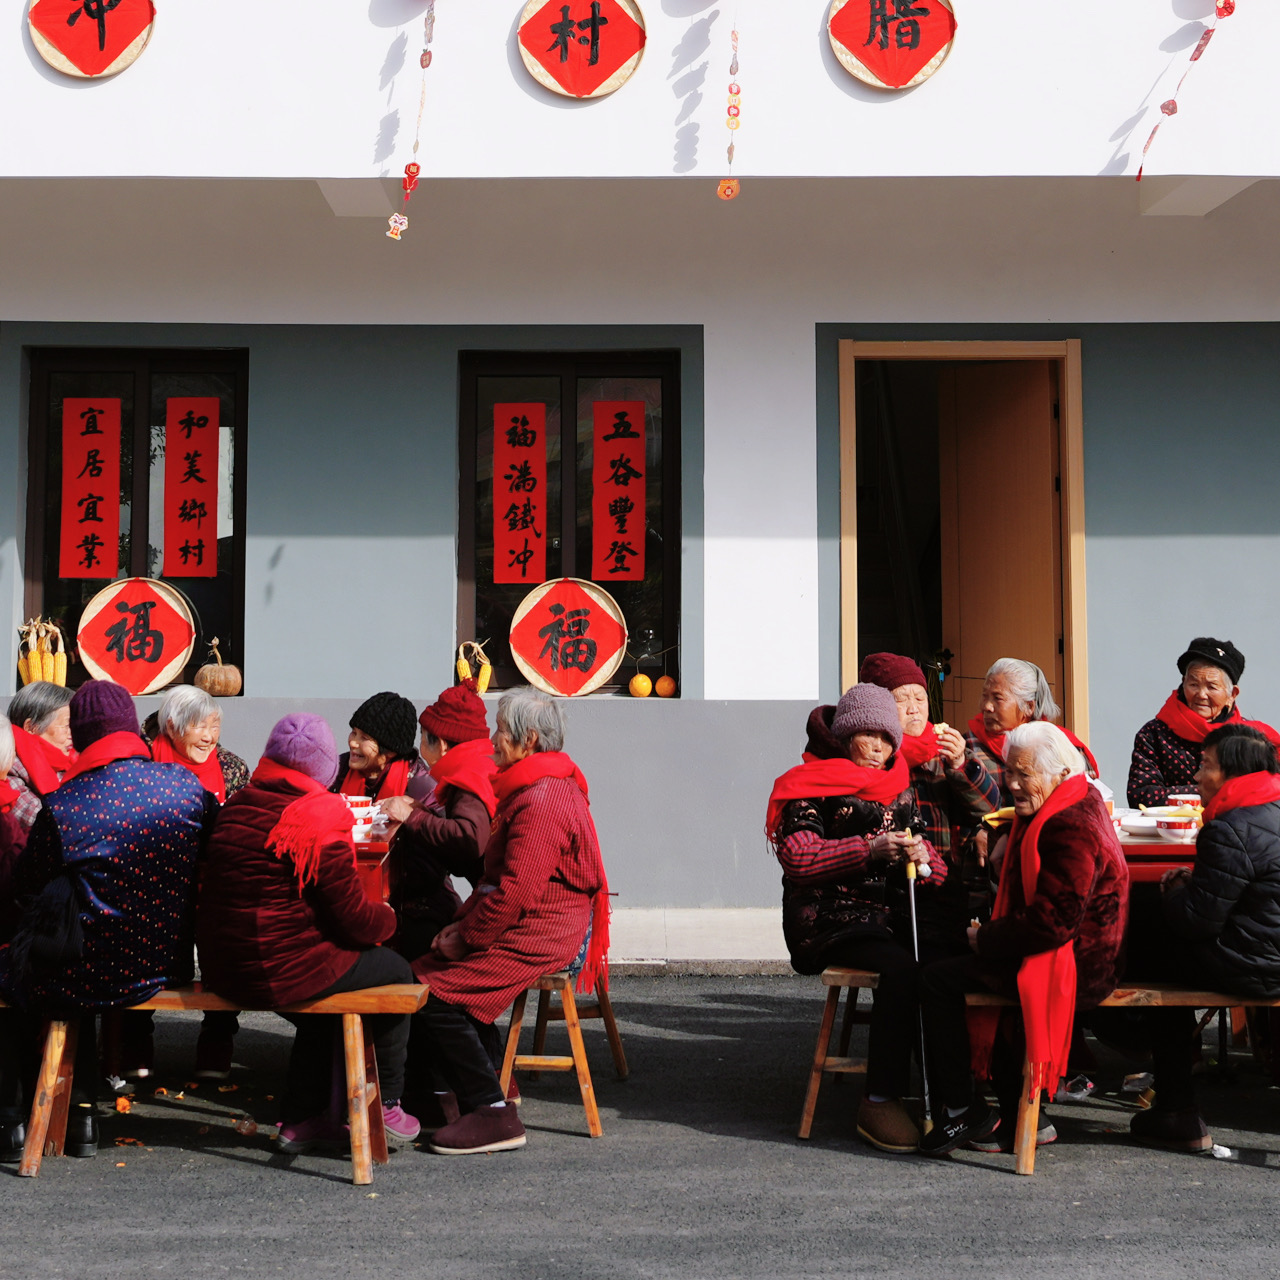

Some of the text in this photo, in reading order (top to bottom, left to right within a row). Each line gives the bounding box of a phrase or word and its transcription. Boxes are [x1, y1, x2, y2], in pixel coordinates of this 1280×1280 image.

[546, 1, 608, 66] 村
[105, 600, 164, 664] 福
[539, 603, 598, 673] 福
